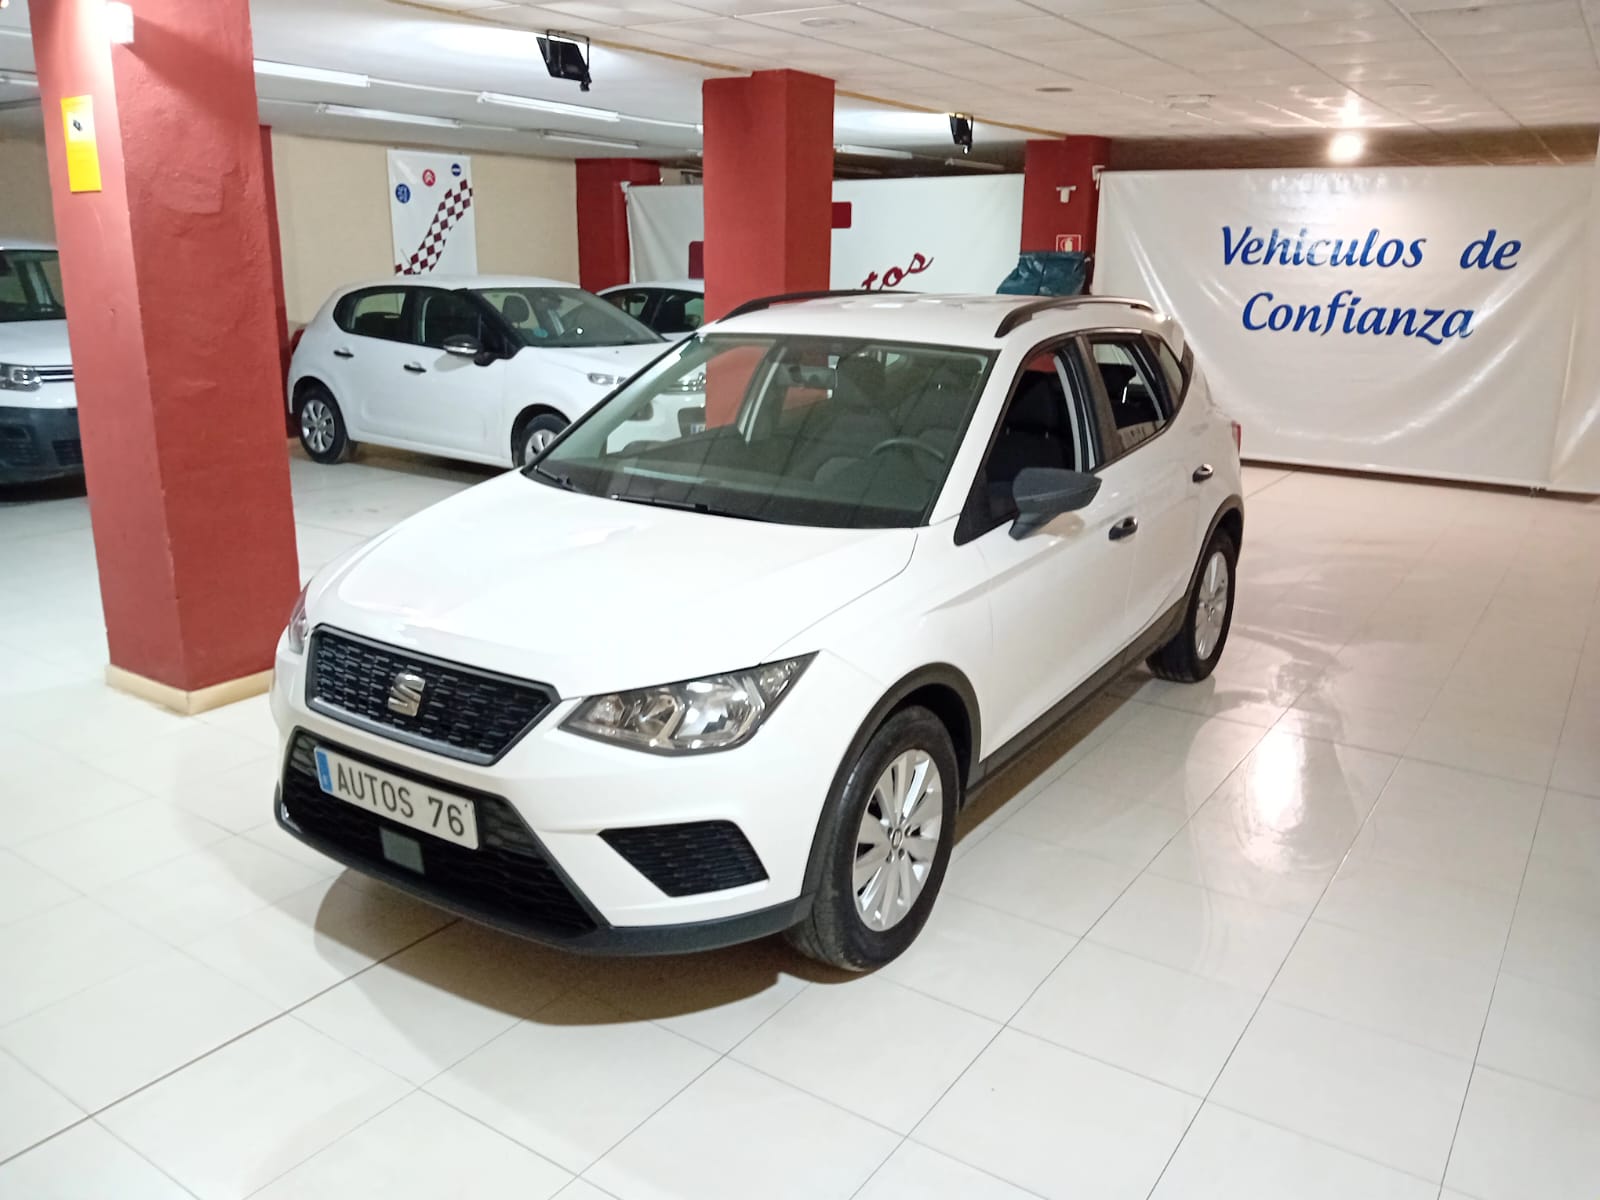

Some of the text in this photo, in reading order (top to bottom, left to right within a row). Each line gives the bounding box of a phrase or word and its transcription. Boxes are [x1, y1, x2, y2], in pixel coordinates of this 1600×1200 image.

[1459, 229, 1522, 270] de
[1241, 289, 1475, 345] Confianza
[337, 762, 465, 837] AUTOS 76
